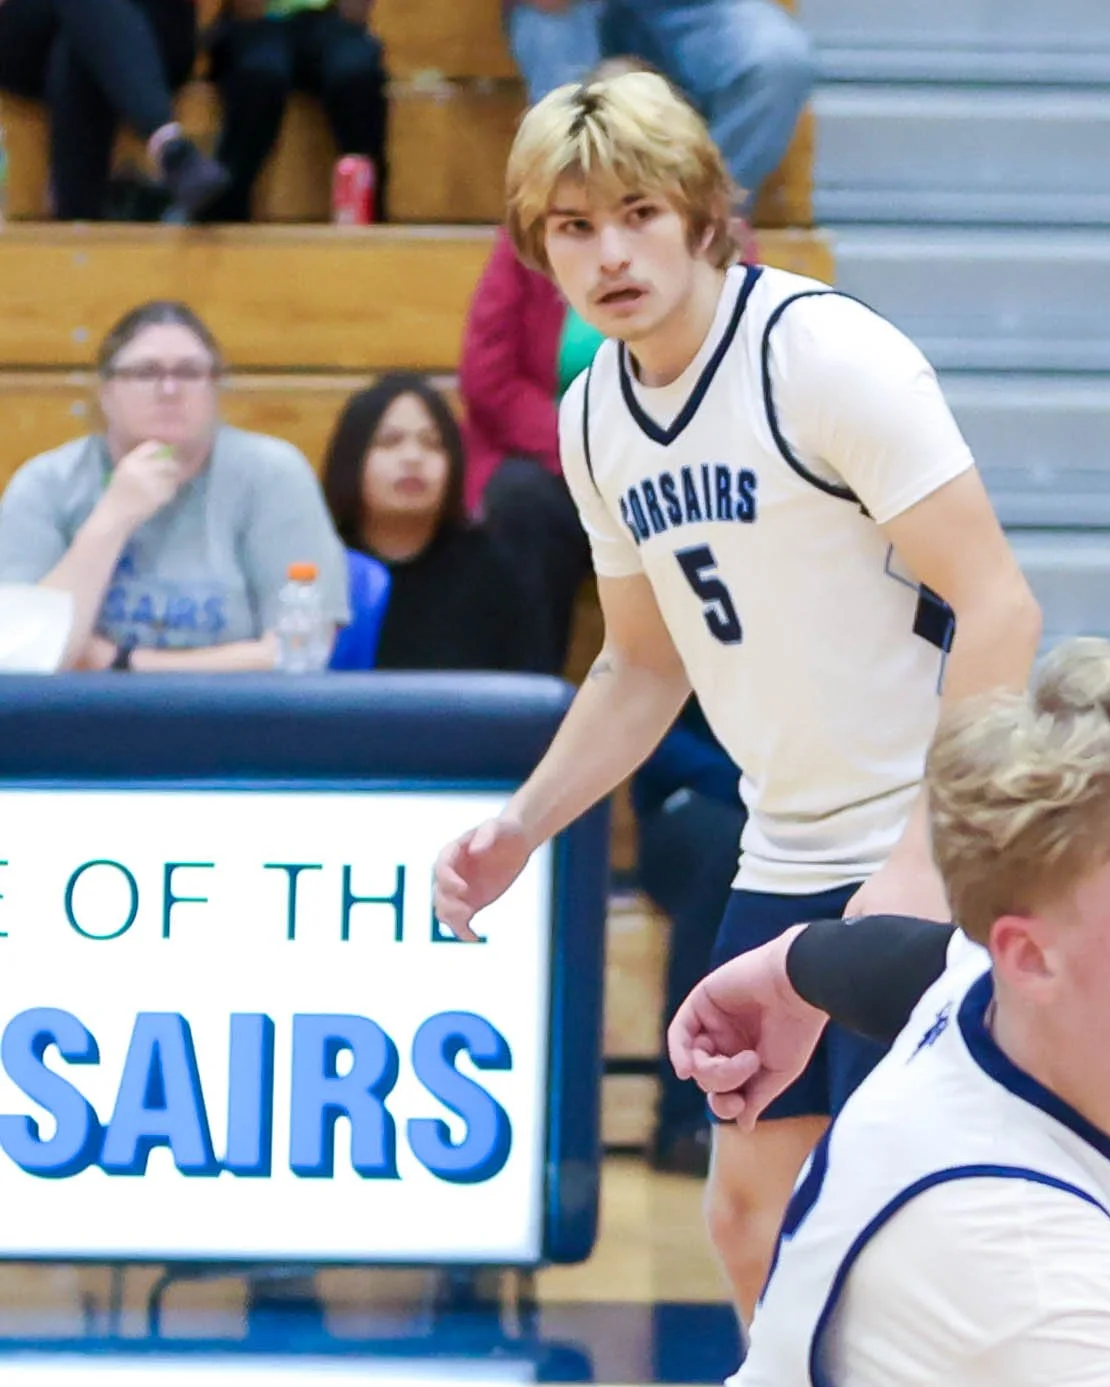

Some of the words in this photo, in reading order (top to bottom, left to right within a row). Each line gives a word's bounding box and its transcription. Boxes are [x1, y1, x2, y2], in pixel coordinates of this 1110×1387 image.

[673, 543, 743, 646] 5
[64, 858, 216, 941] OF
[0, 1006, 513, 1186] SAIRS
